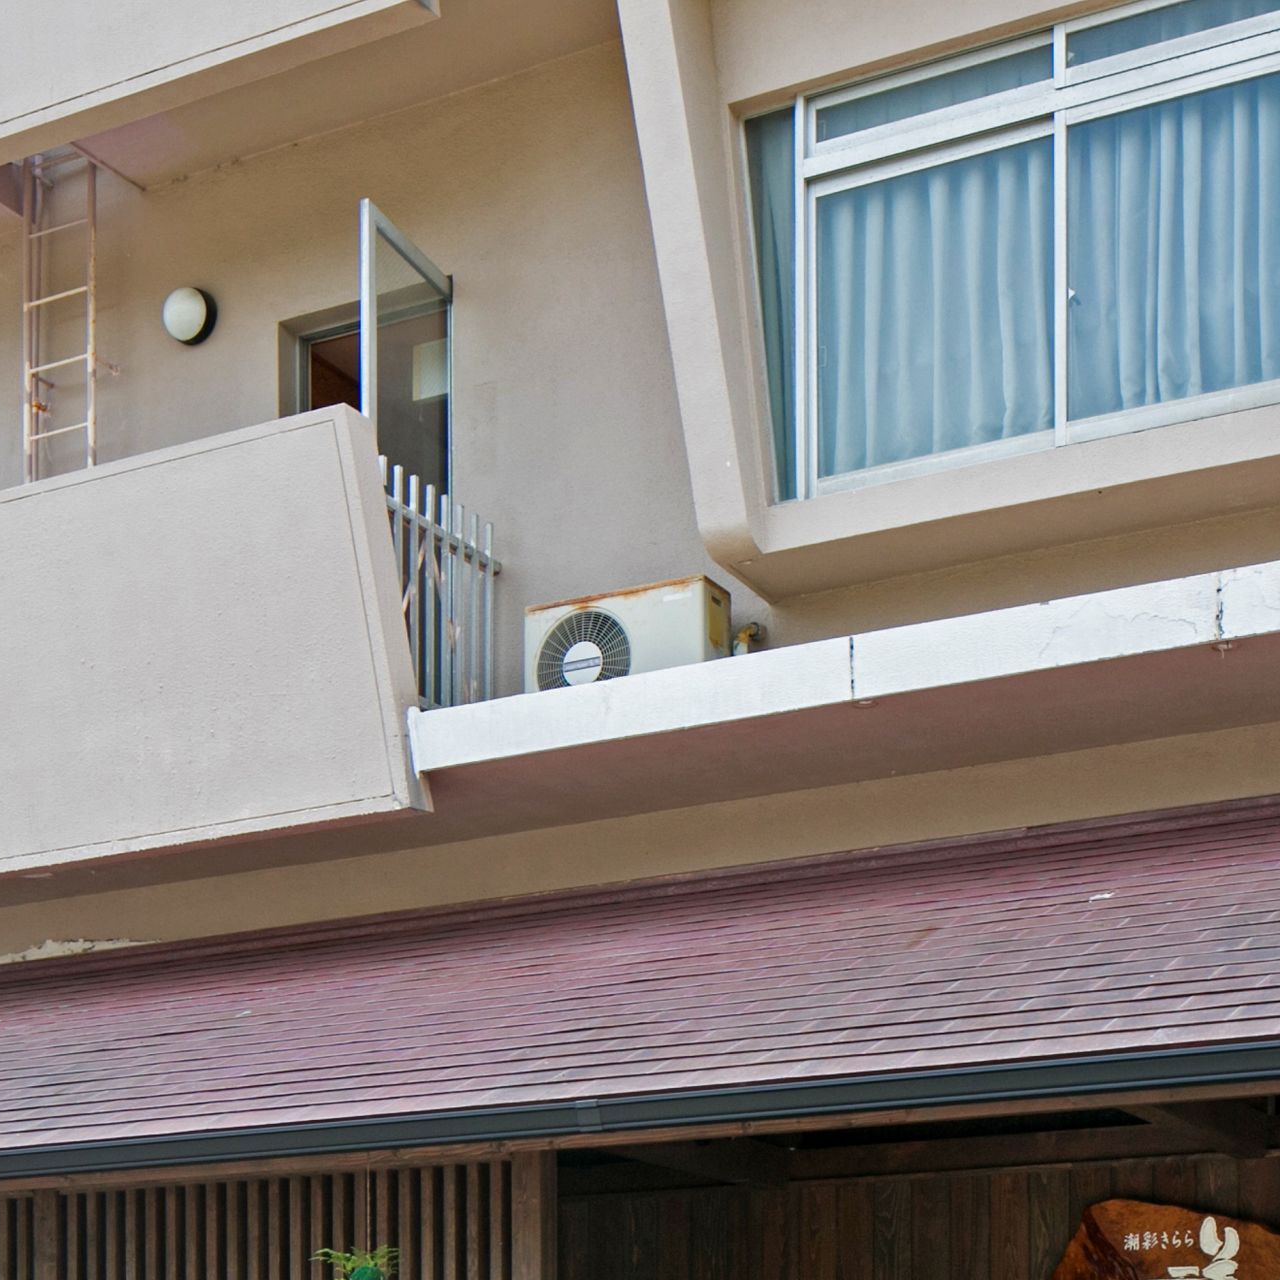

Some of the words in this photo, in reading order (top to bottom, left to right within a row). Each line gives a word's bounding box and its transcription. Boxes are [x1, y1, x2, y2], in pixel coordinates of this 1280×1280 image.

[1124, 1230, 1194, 1251] 潮彩きらら
